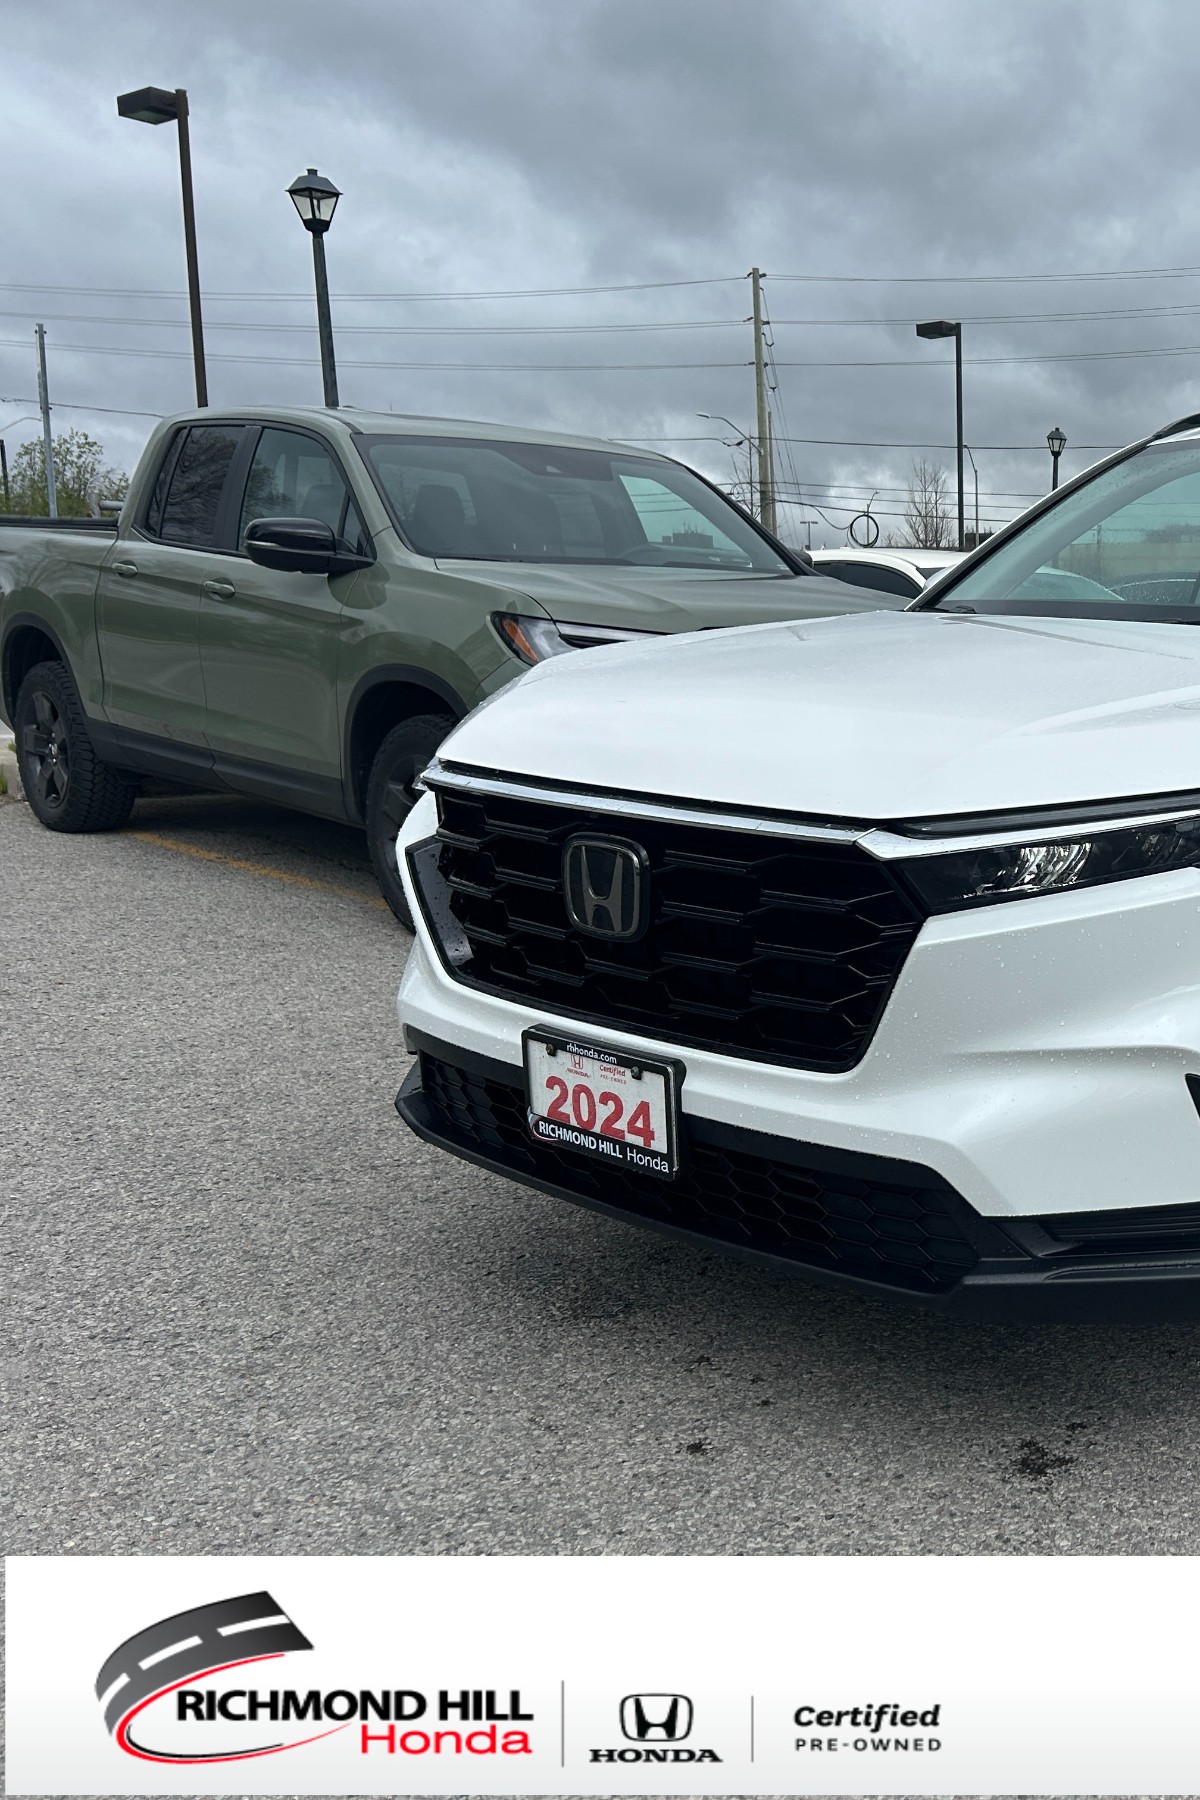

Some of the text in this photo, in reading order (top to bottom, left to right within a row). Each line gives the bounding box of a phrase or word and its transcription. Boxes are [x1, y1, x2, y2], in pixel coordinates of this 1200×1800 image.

[566, 1043, 617, 1064] rhhonda.com
[600, 1064, 626, 1077] Certified
[545, 1075, 655, 1148] 2024
[538, 1120, 670, 1173] RICHMOND HILL Honda
